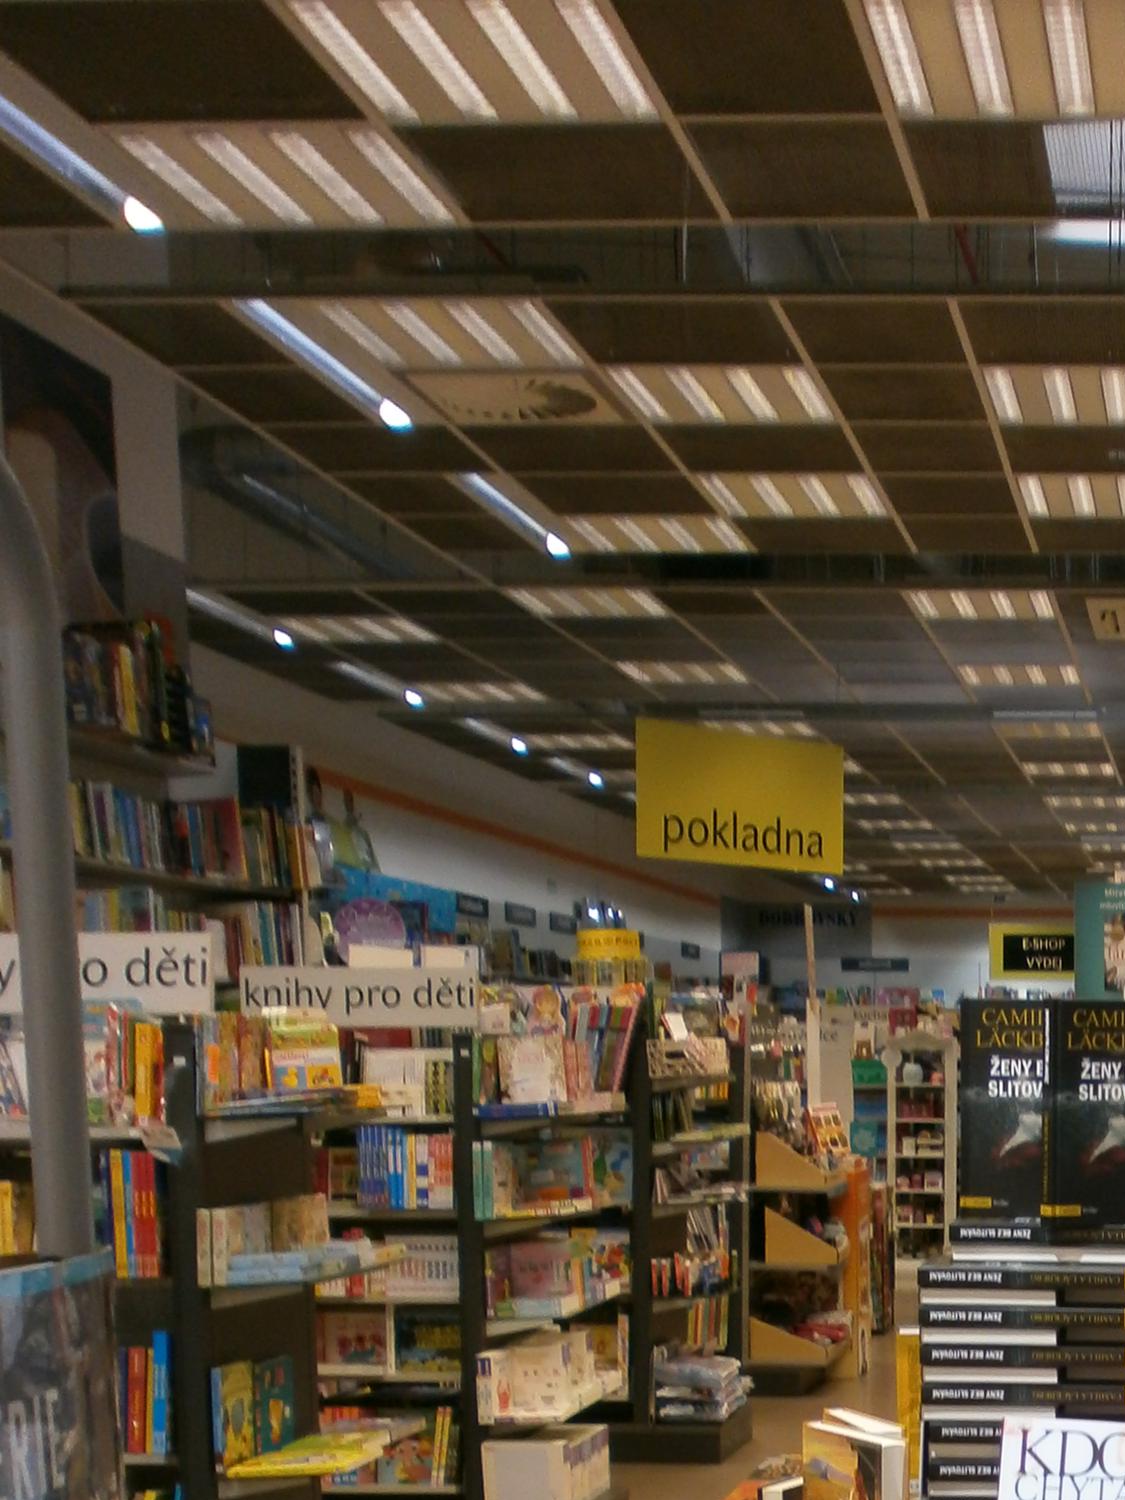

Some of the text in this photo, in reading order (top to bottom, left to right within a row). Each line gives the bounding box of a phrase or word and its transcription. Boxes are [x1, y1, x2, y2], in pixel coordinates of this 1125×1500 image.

[663, 807, 823, 858] pokladna
[1022, 937, 1066, 952] E-SHOP
[124, 946, 209, 987] děti
[1025, 955, 1063, 970] VÝDEJ
[244, 976, 477, 1015] knihy pro děti
[976, 1028, 1044, 1049] LÄCKB
[990, 1055, 1032, 1077] ŽENY
[1081, 1057, 1121, 1080] ŽENY
[988, 1080, 1043, 1099] SLITOV
